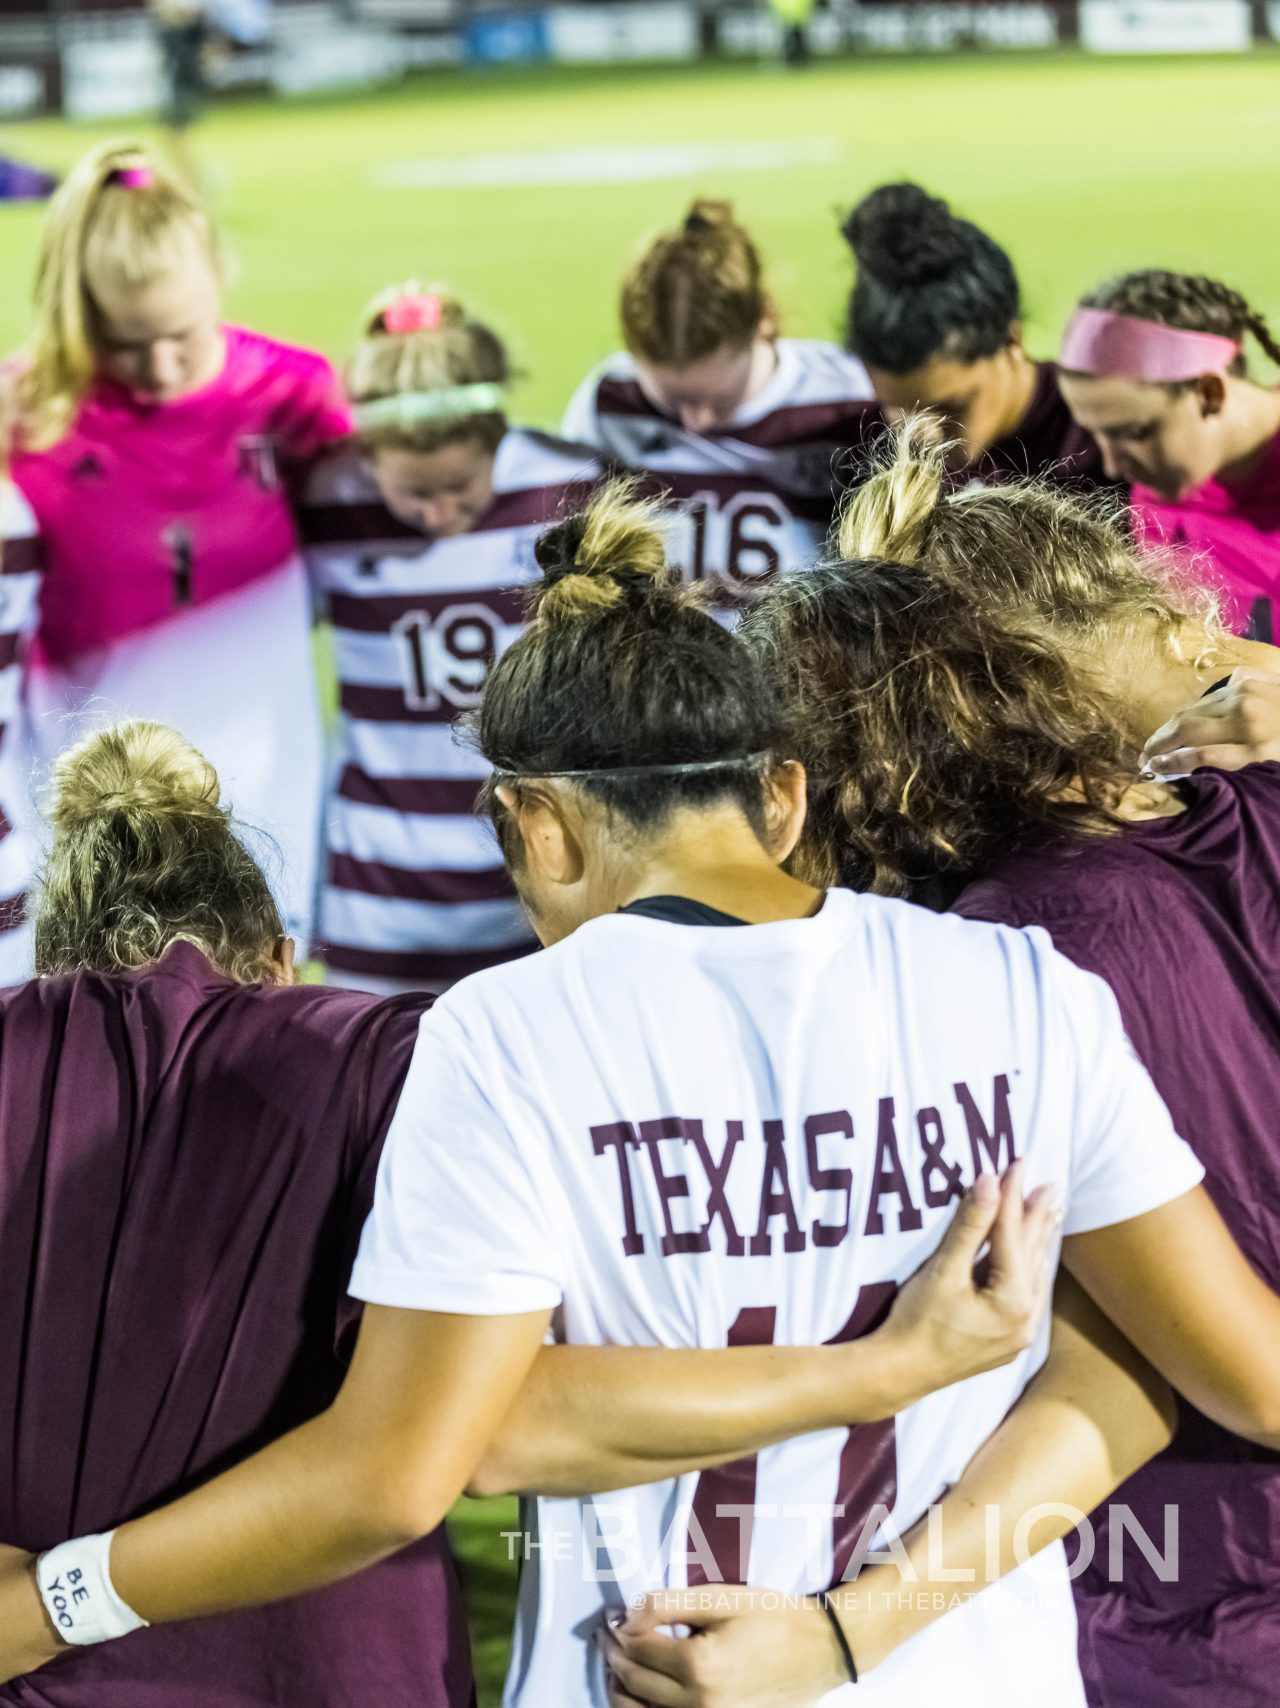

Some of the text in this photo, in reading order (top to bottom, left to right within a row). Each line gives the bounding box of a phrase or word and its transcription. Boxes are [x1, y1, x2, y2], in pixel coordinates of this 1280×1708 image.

[686, 495, 786, 590] 16
[396, 607, 497, 706] 19
[589, 1074, 1017, 1257] TEXAS A&M
[66, 1567, 90, 1607] BE
